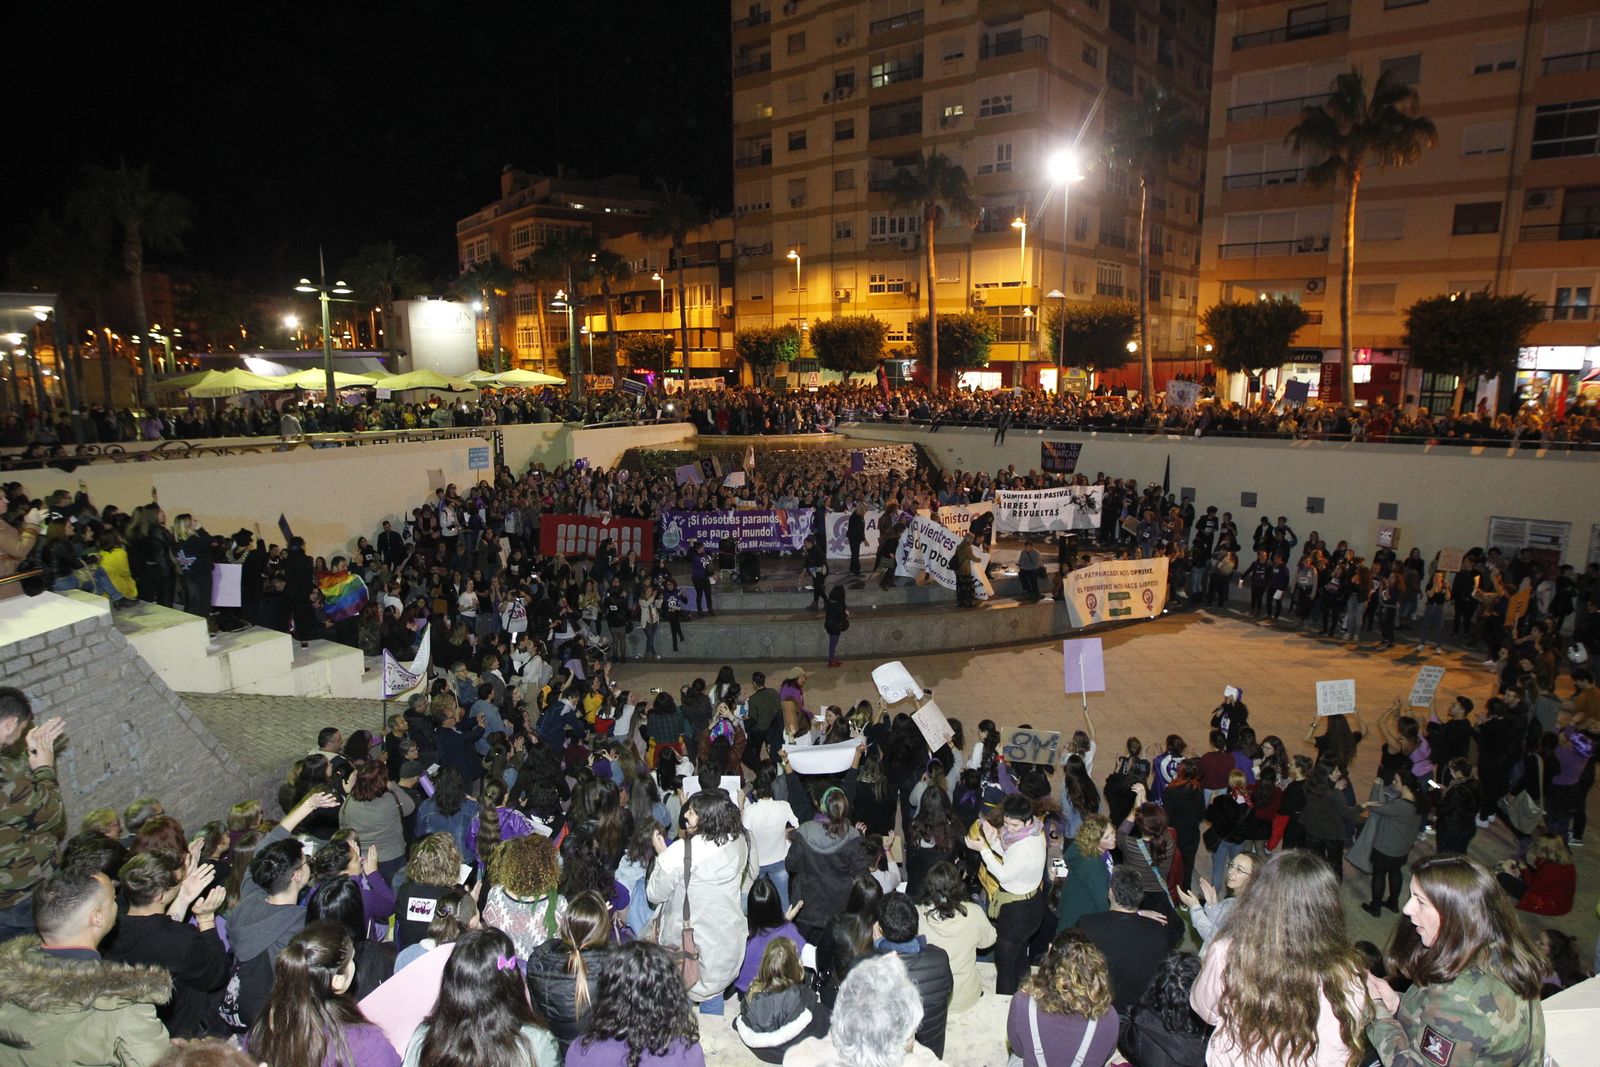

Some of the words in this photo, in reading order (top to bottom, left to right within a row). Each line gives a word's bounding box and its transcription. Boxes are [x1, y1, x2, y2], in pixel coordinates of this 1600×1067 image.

[1003, 492, 1032, 500] SUMISAS
[1044, 489, 1072, 499] PASIVAS
[999, 501, 1028, 509] LIBRES
[941, 512, 970, 525] inista
[1012, 508, 1060, 517] REVUELTAS
[688, 514, 700, 527] ¡Si
[702, 514, 740, 526] nosotras
[697, 530, 708, 538] se
[710, 529, 730, 541] para
[732, 527, 740, 538] el
[742, 526, 774, 538] mundo!
[920, 522, 956, 551] vientres
[1004, 731, 1060, 764] 8M
